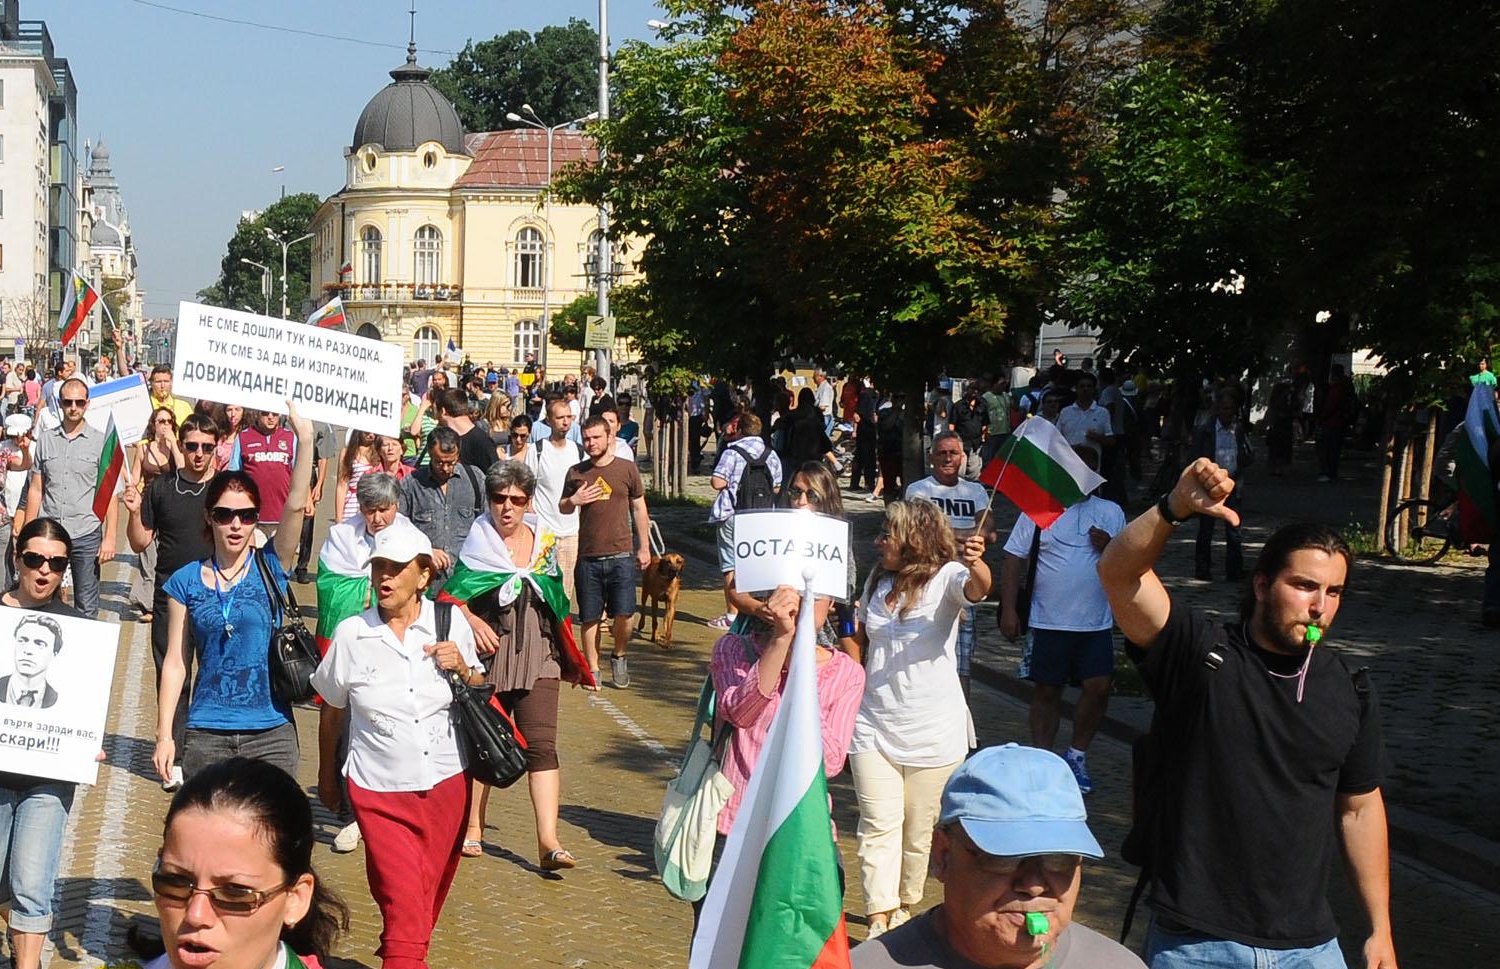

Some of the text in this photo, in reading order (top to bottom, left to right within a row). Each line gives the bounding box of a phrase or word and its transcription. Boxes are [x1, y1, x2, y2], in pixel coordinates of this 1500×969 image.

[199, 314, 383, 363] НЕ СМЕ ДОШЛИ ТУК НА РАЗХОДКА.
[208, 340, 368, 384] ТУК СМЕ ЗА ДА ВИ ИЗПРАТИМ.
[183, 360, 393, 419] ДОВИЖДАНЕ! ДОВИЖДАНЕ!
[736, 539, 843, 563] ОСТАВКА
[3, 718, 33, 729] въртя
[36, 722, 73, 737] заради
